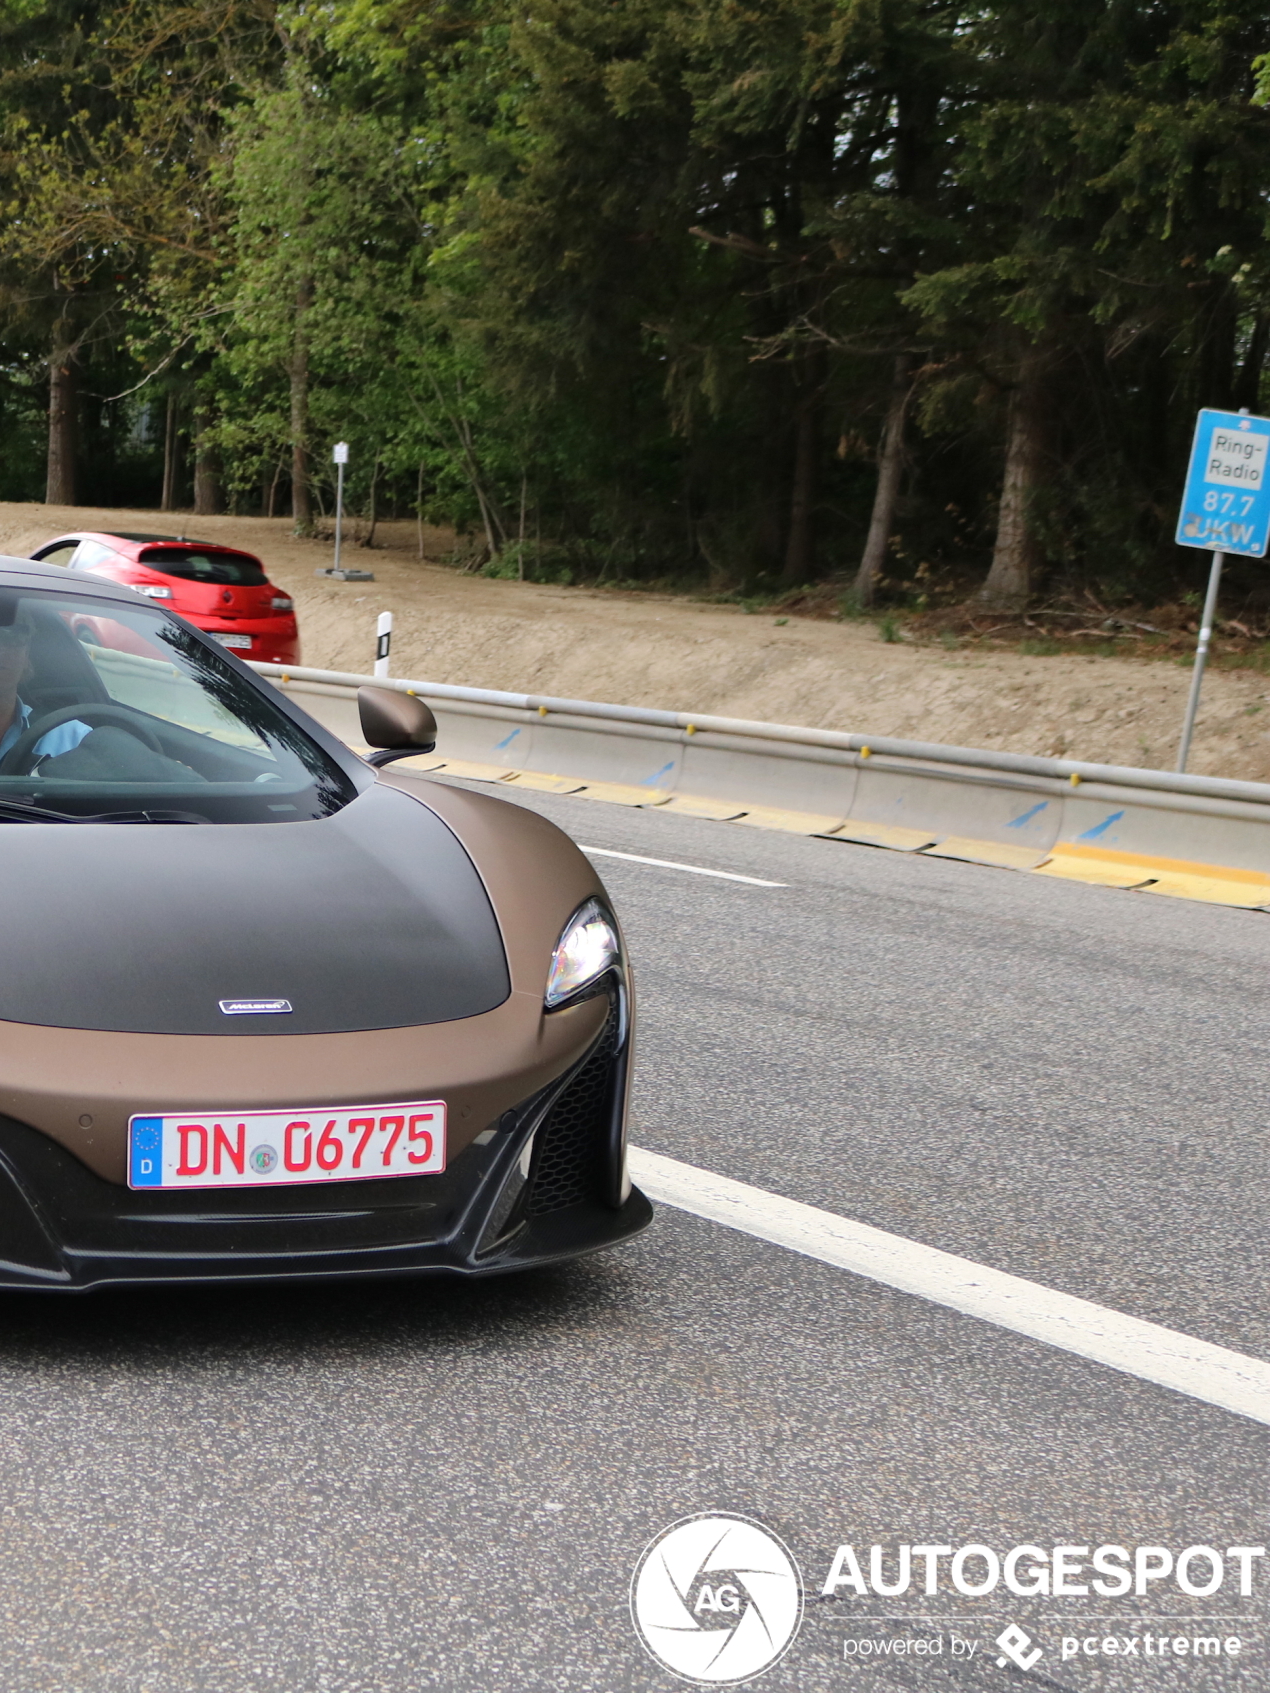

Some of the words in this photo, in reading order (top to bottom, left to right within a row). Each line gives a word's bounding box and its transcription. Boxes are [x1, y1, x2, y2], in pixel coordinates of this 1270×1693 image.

[1215, 435, 1262, 459] Ring-
[1209, 459, 1260, 481] Radio
[1203, 491, 1255, 516] 87.7
[176, 1123, 246, 1176] DN
[283, 1113, 434, 1172] 06775
